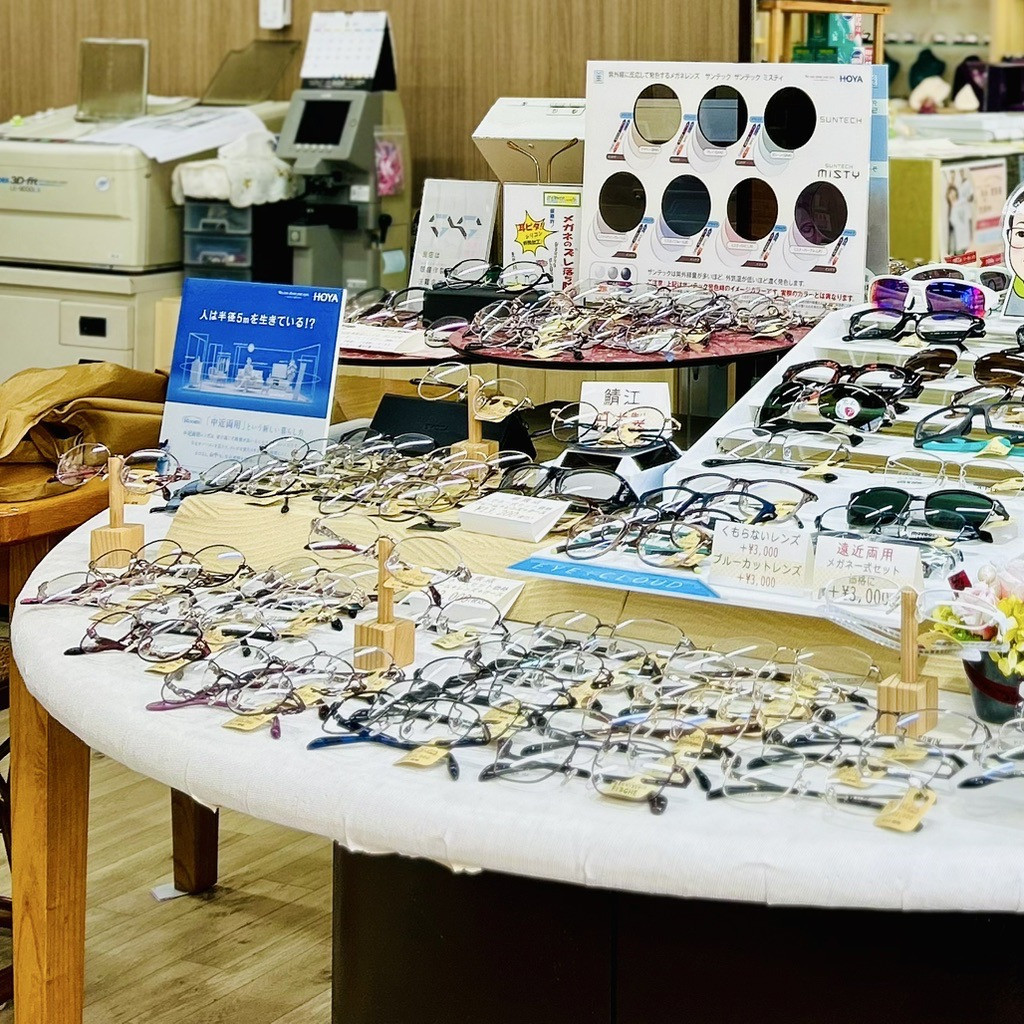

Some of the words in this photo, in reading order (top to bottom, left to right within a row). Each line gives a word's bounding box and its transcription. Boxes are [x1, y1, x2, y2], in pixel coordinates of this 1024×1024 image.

[840, 74, 864, 83] HOYA
[819, 115, 863, 124] SUNTECH
[313, 291, 339, 303] HOYA
[604, 388, 640, 406] 鯖江
[721, 527, 801, 547] くもらないレンズ
[836, 542, 894, 562] 遠近両用
[713, 553, 803, 577] ブルーカットレンズ
[826, 558, 900, 576] メガネ一式セット
[532, 561, 585, 575] EYE
[600, 571, 684, 589] CLOUD
